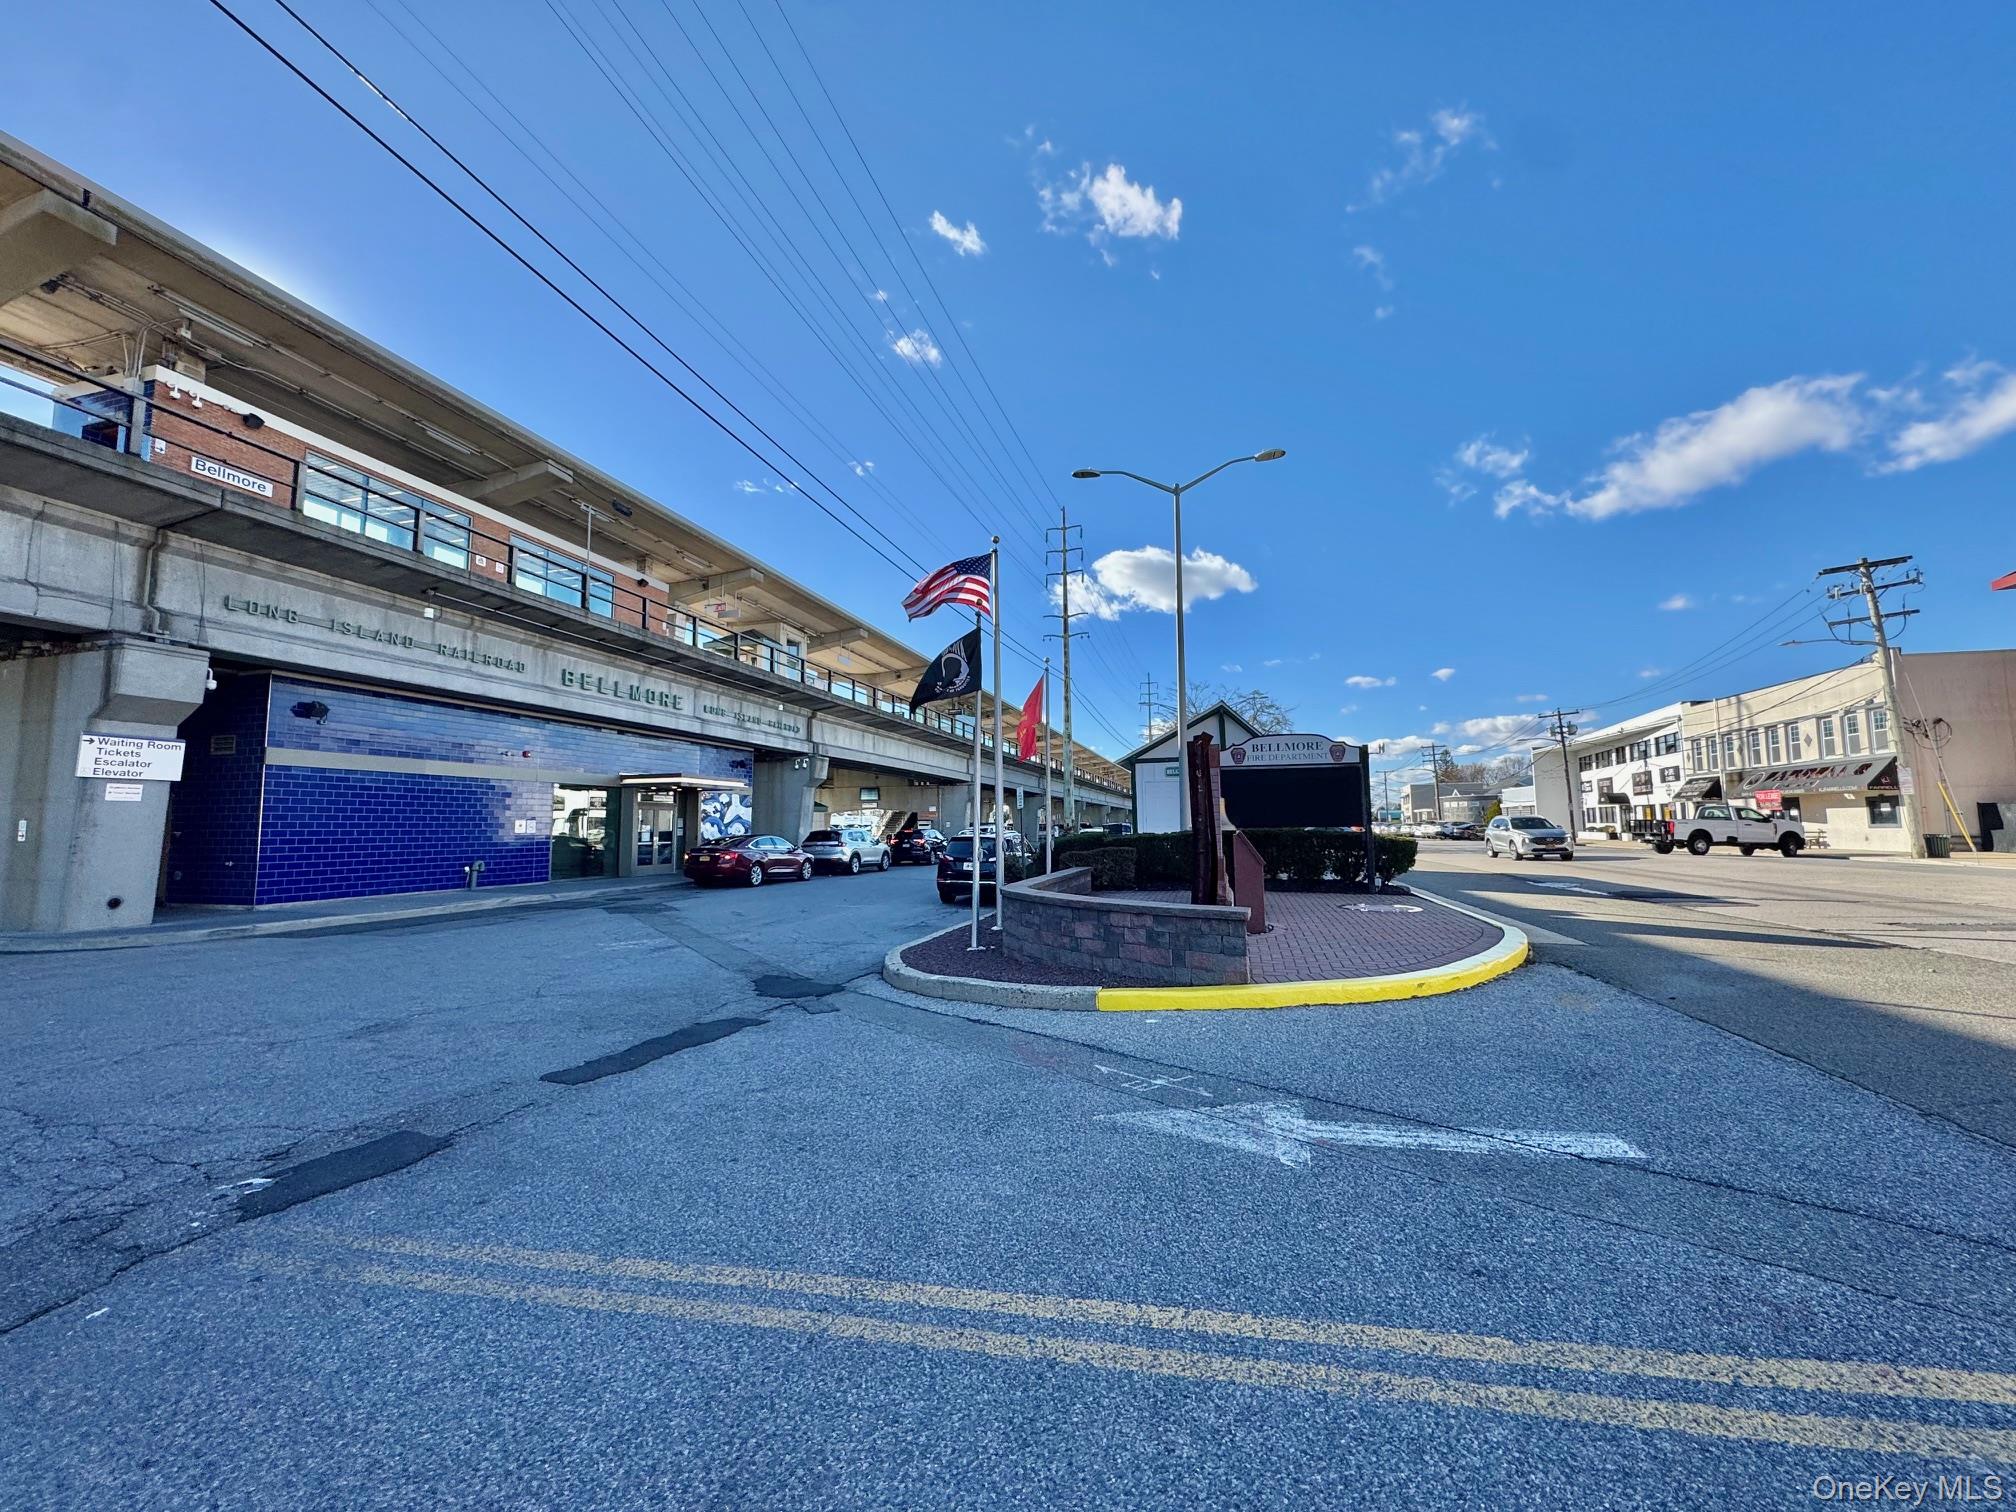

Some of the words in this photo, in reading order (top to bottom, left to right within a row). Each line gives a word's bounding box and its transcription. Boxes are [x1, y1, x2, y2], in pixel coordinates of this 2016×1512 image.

[195, 458, 267, 493] Bellmore
[225, 594, 299, 624] LONG
[331, 617, 414, 649] ISLAND
[438, 642, 525, 674] RAILROAD
[562, 668, 684, 711] BELLMORE
[98, 737, 143, 750] Waiting
[147, 741, 182, 751] Room
[1252, 741, 1324, 753] BELLMORE
[97, 747, 141, 758] Tickets
[1247, 754, 1266, 762] FIRE
[1268, 752, 1328, 761] DEPARTMENT
[94, 757, 152, 768] Escalator
[92, 767, 144, 777] Elevator
